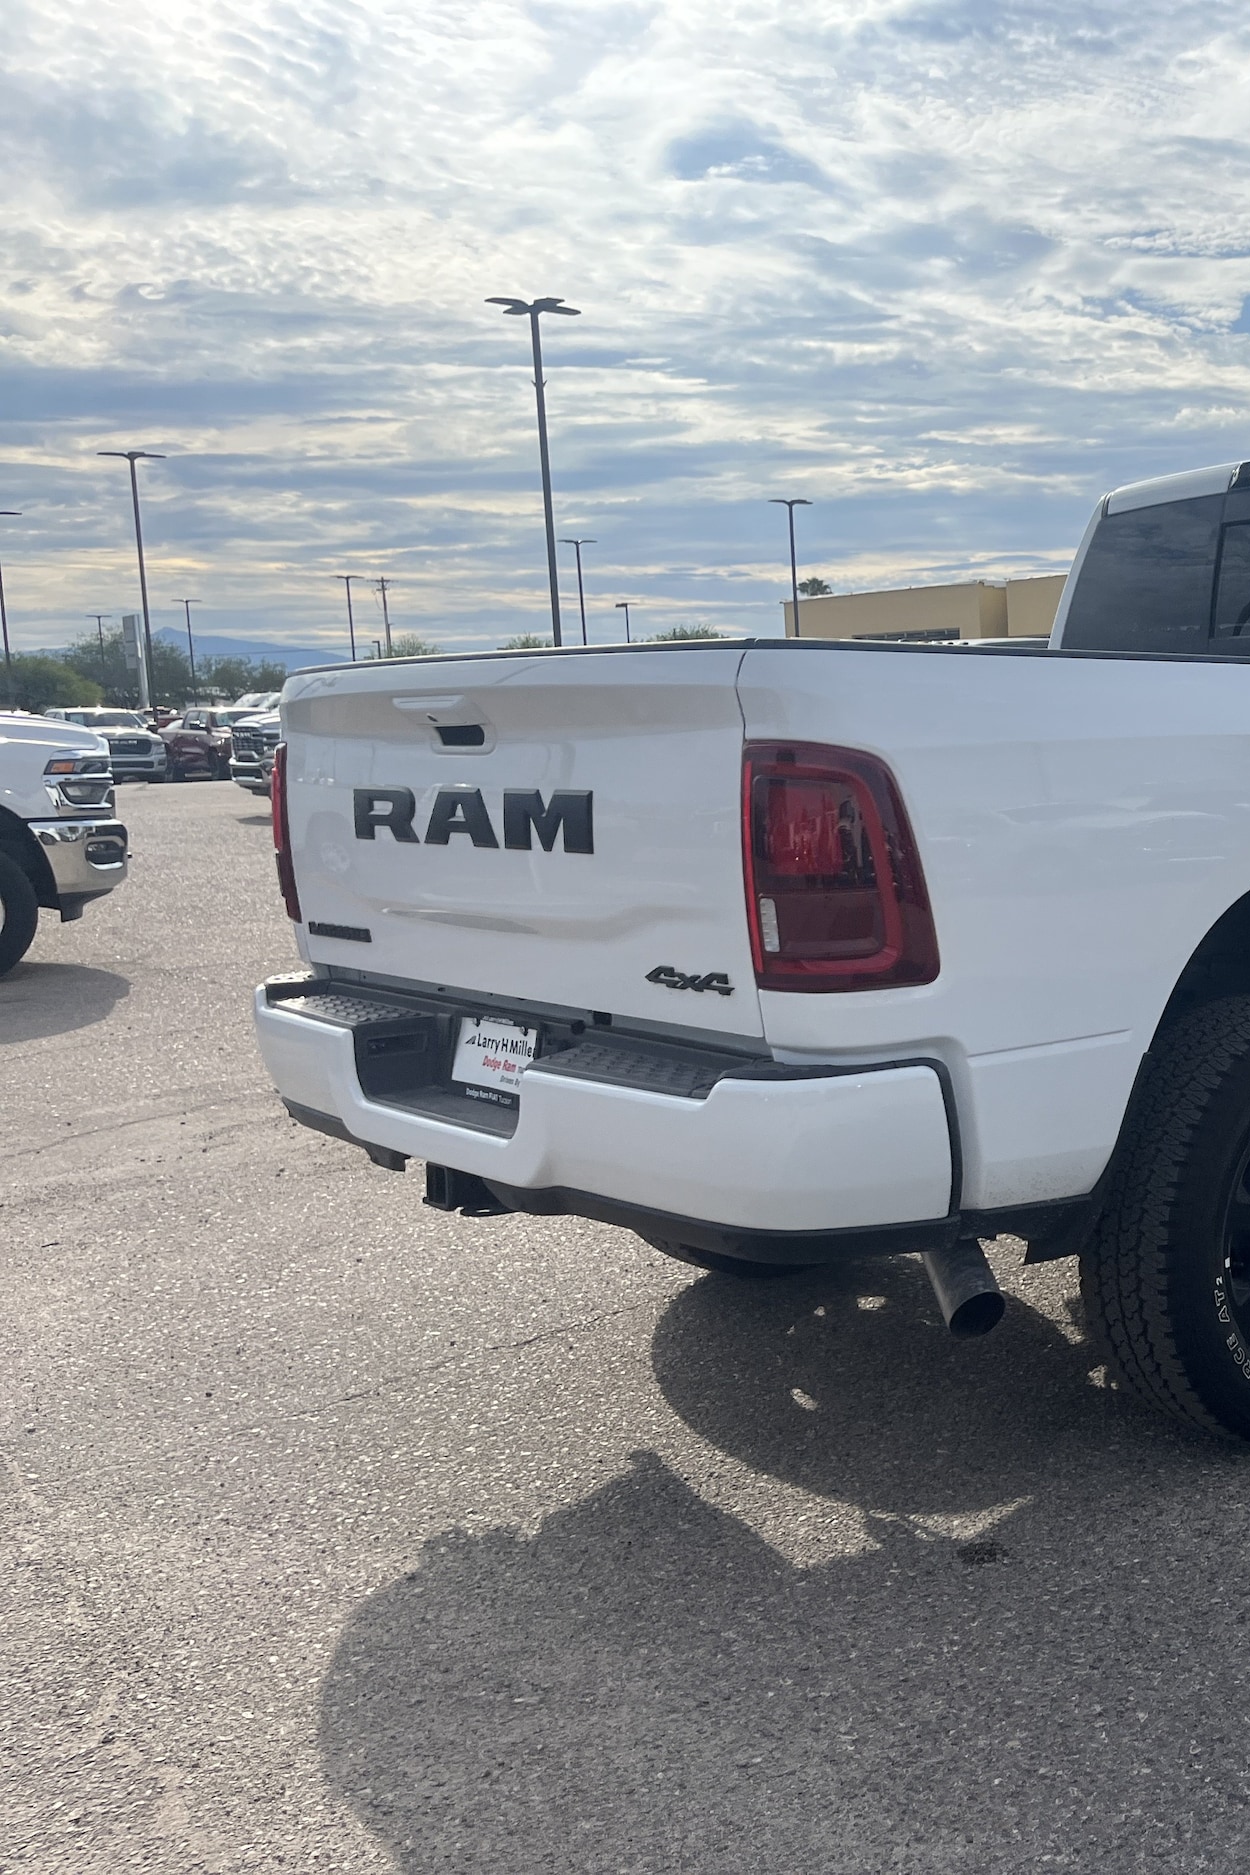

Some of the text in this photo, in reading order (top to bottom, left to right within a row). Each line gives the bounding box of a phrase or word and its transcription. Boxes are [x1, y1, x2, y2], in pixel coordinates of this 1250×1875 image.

[353, 784, 595, 854] RAM
[645, 965, 735, 996] 4x4
[477, 1033, 501, 1054] Larry
[501, 1037, 509, 1052] H
[482, 1055, 502, 1072] Dodge
[502, 1059, 517, 1073] Ram
